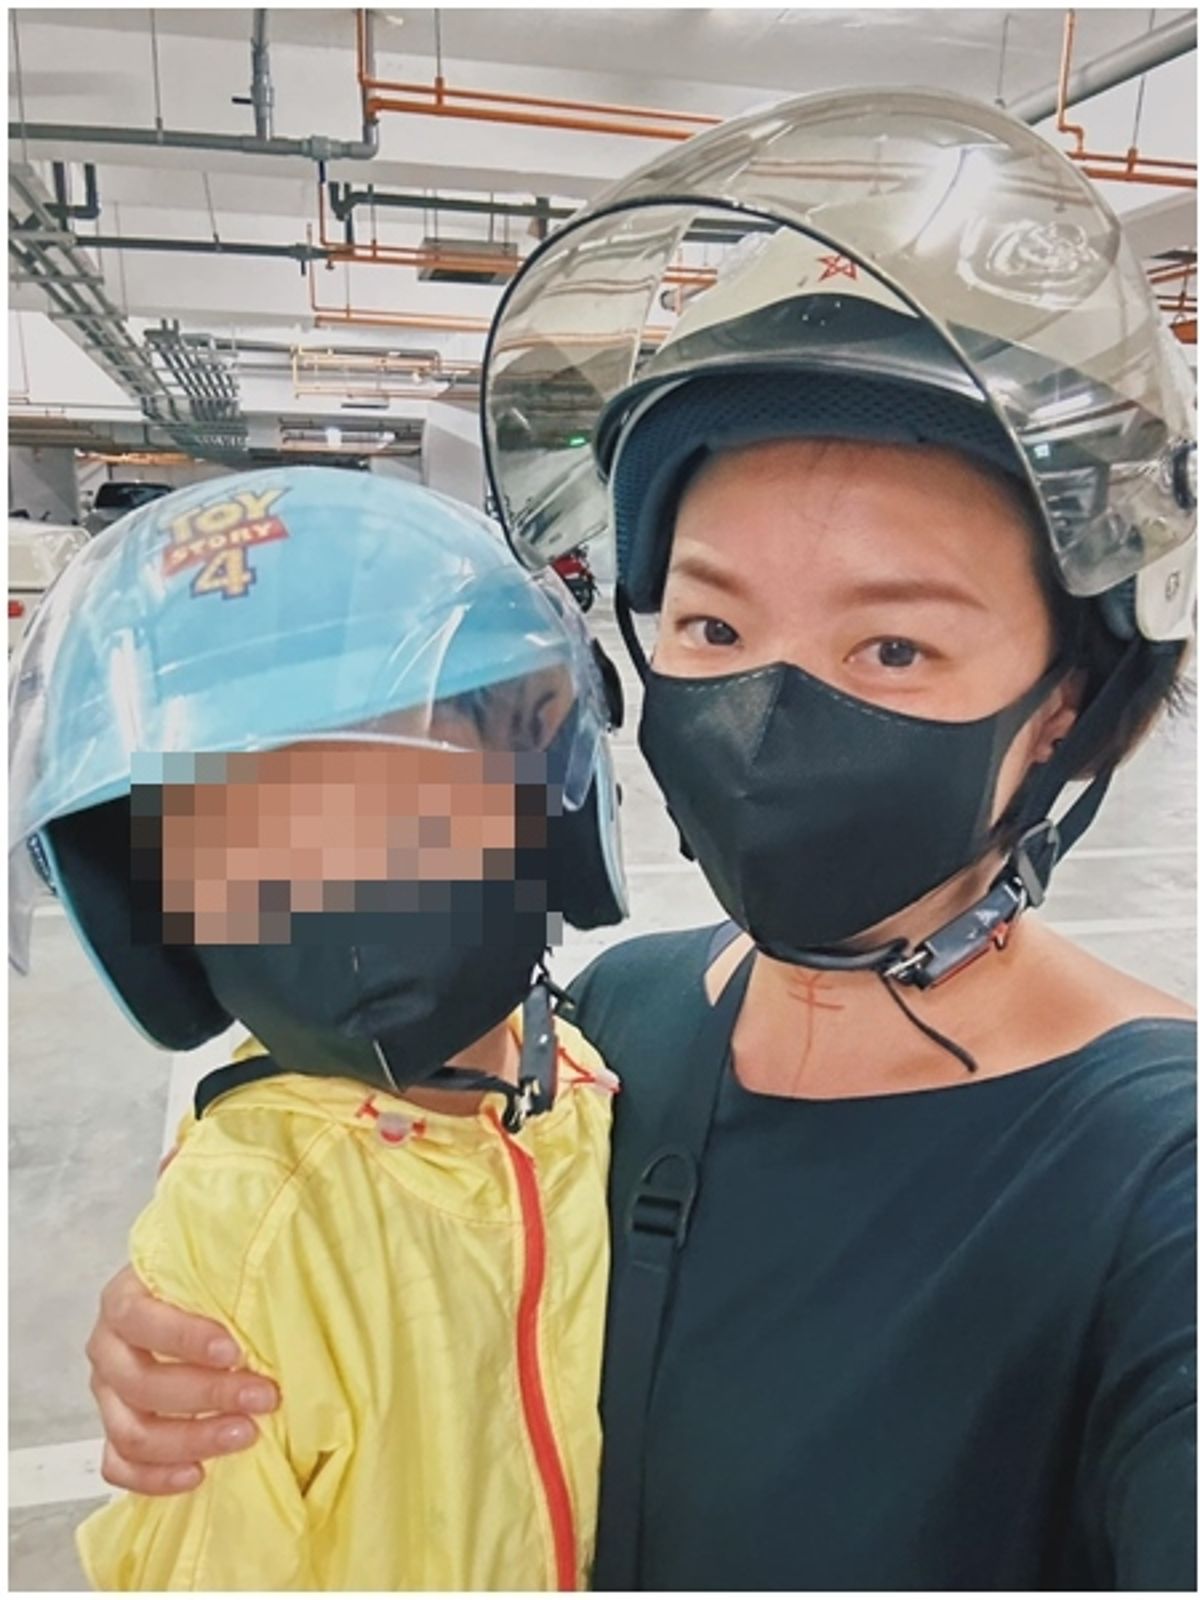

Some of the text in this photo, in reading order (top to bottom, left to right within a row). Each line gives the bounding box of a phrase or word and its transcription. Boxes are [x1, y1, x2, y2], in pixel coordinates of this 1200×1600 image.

[162, 487, 291, 543] TOY
[169, 521, 273, 565] STORY
[190, 547, 256, 600] 4
